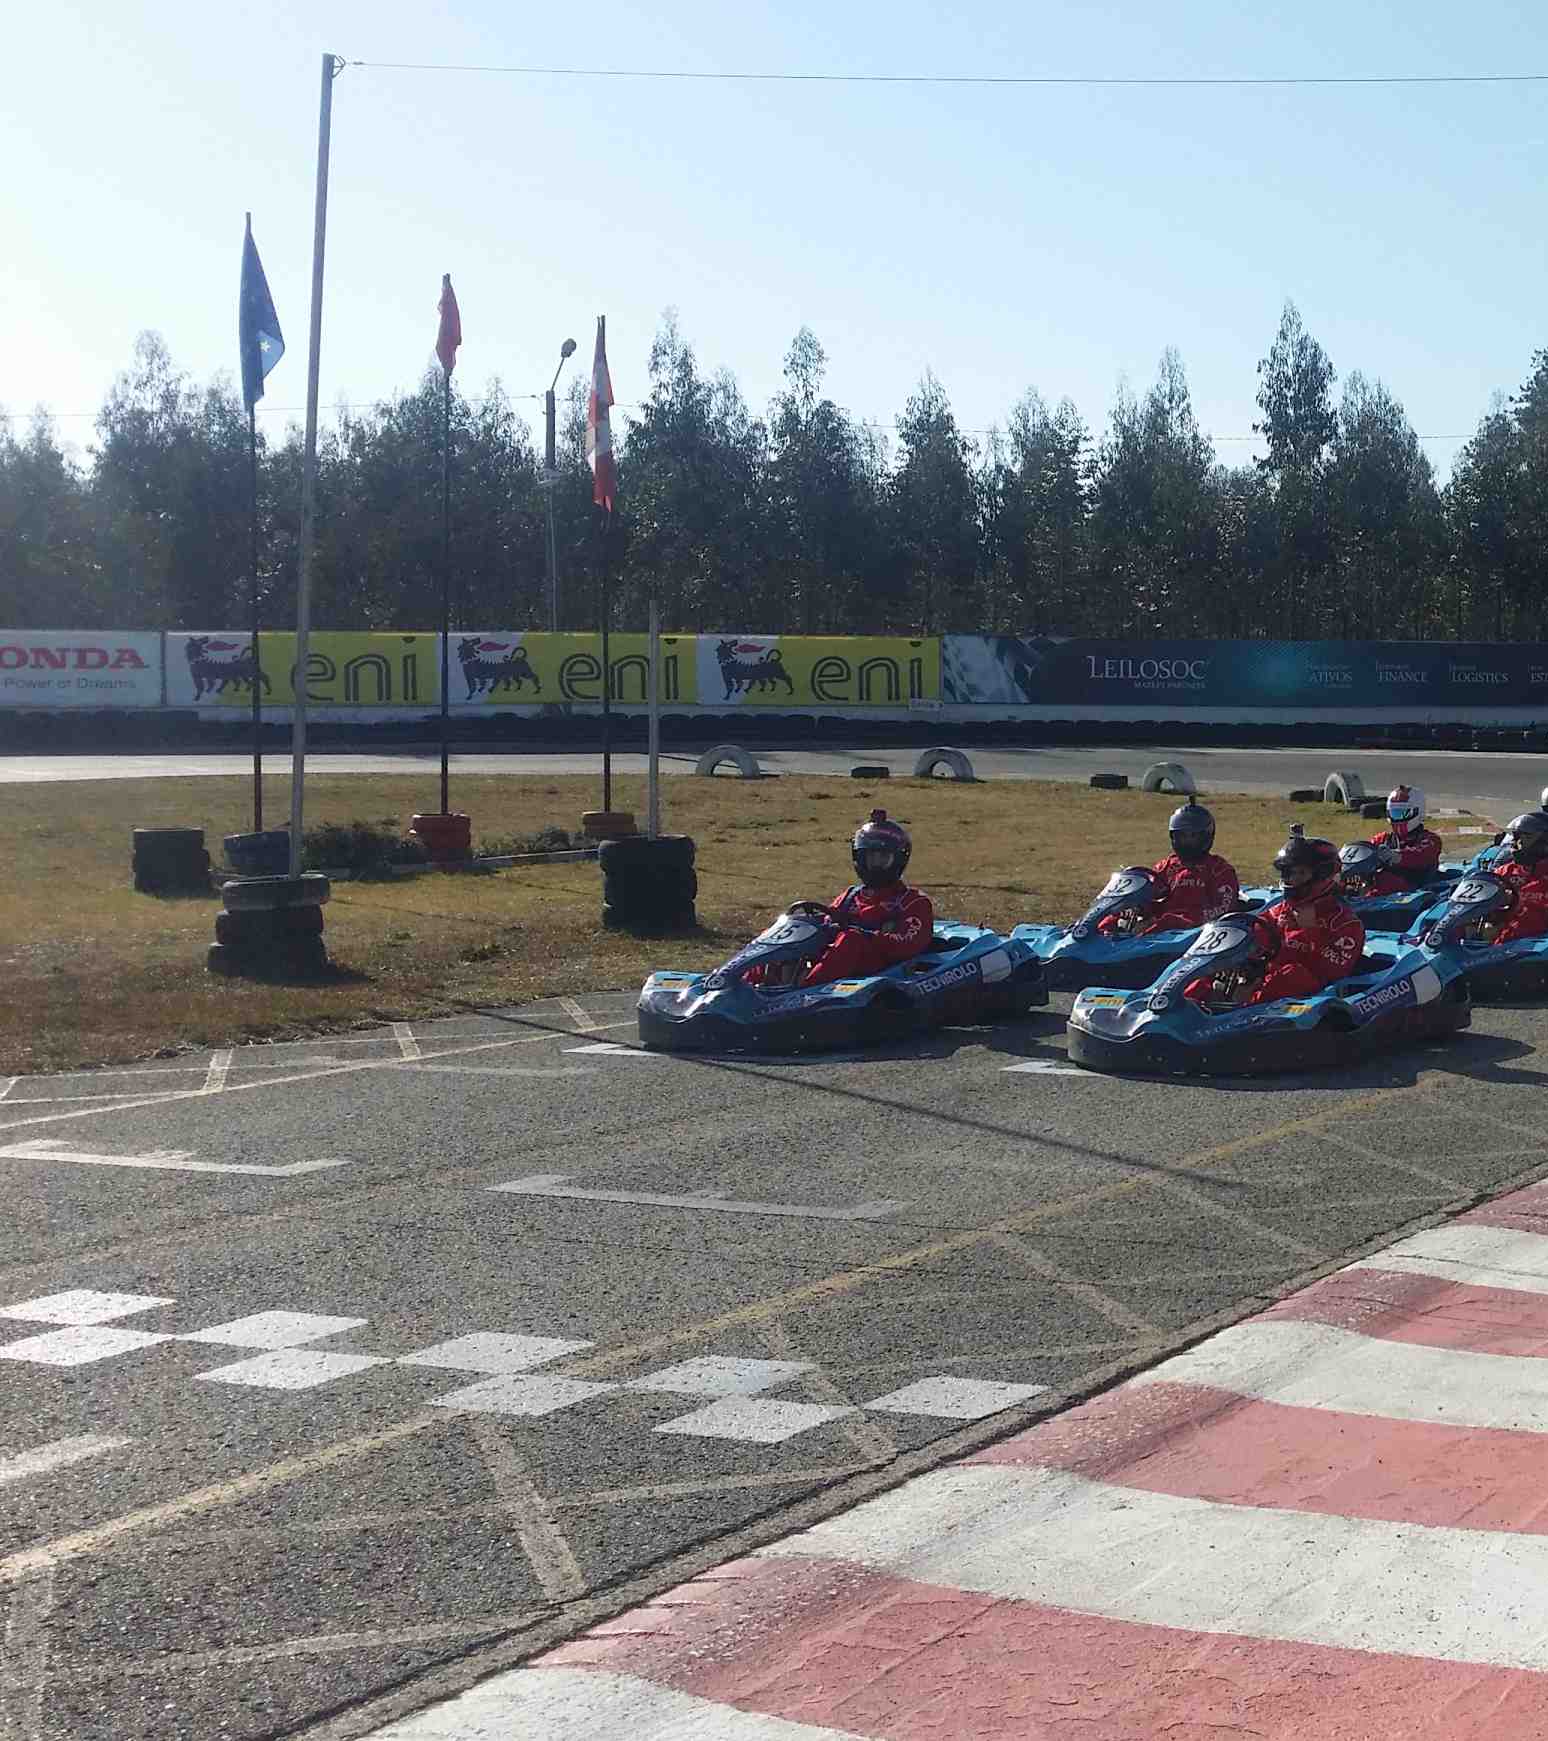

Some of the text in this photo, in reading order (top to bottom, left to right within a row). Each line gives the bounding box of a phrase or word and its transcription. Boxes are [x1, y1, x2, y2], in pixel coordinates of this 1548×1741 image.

[0, 647, 149, 669] ONDA
[291, 637, 420, 701] eni
[558, 638, 679, 700] eni
[809, 640, 923, 700] eni
[1458, 883, 1484, 899] 22
[1196, 931, 1228, 951] 28
[916, 962, 977, 995] TECNIROLO
[1357, 979, 1411, 1015] TECNIROLO
